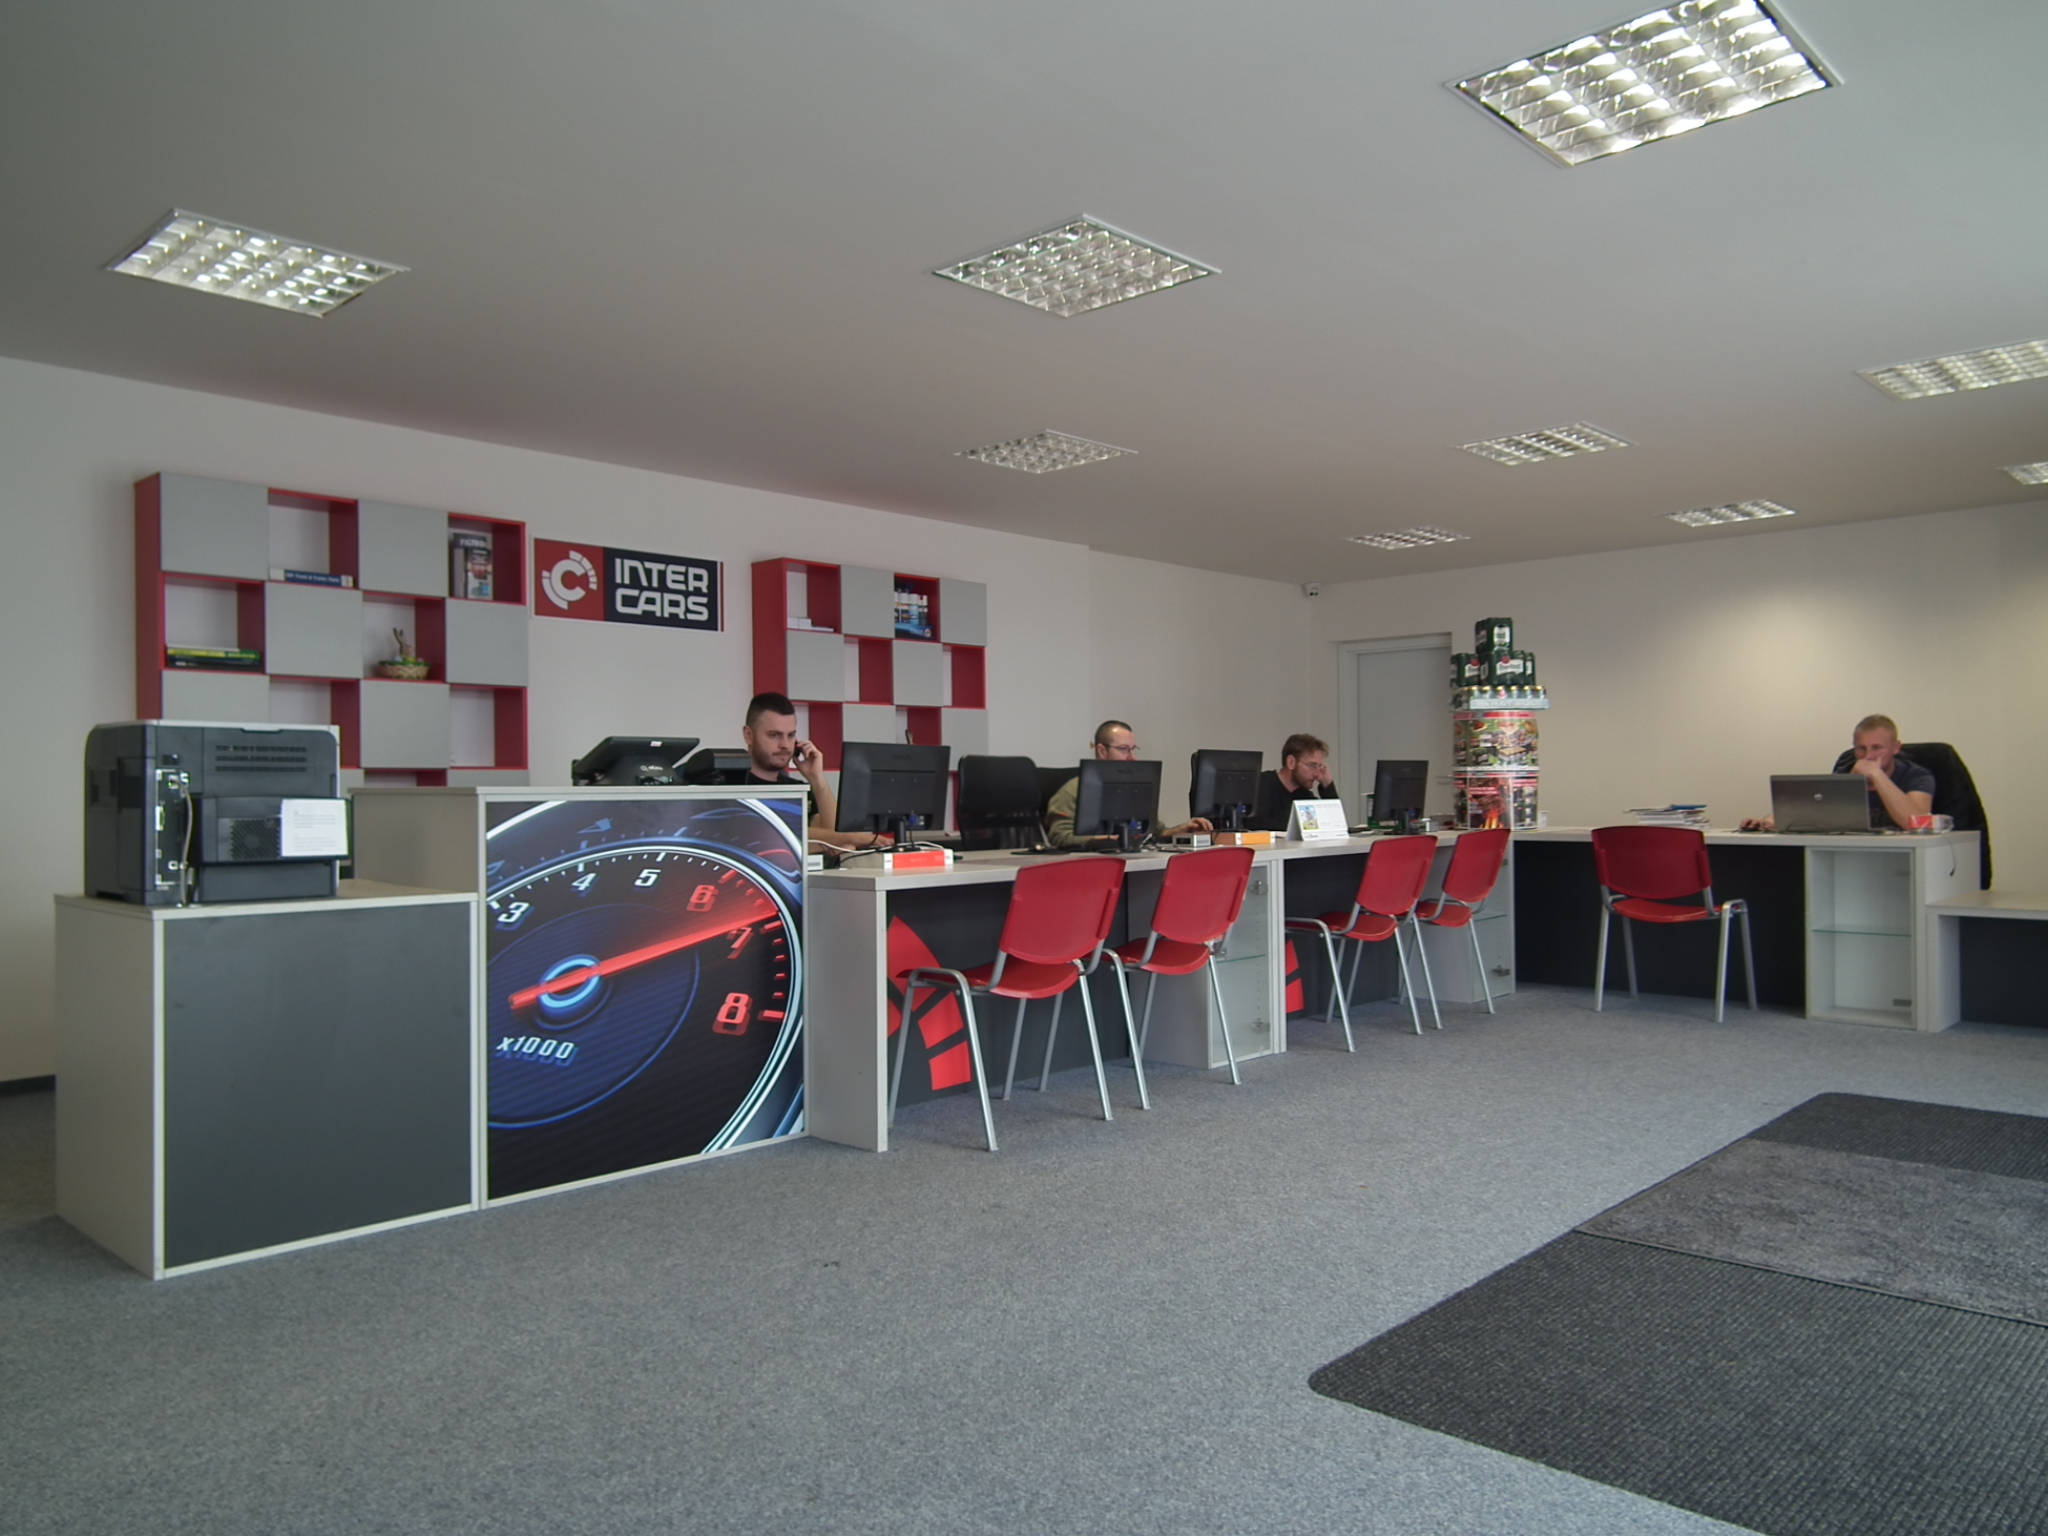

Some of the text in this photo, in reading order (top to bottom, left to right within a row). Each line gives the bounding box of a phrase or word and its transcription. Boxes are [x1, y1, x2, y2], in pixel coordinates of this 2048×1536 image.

[614, 557, 709, 593] INTER
[614, 587, 709, 621] CARS
[571, 873, 597, 892] 4
[634, 868, 662, 888] 5
[688, 884, 717, 906] 6
[497, 901, 530, 923] 3
[729, 926, 752, 950] 7
[716, 992, 750, 1026] 8
[495, 1036, 575, 1060] x1000
